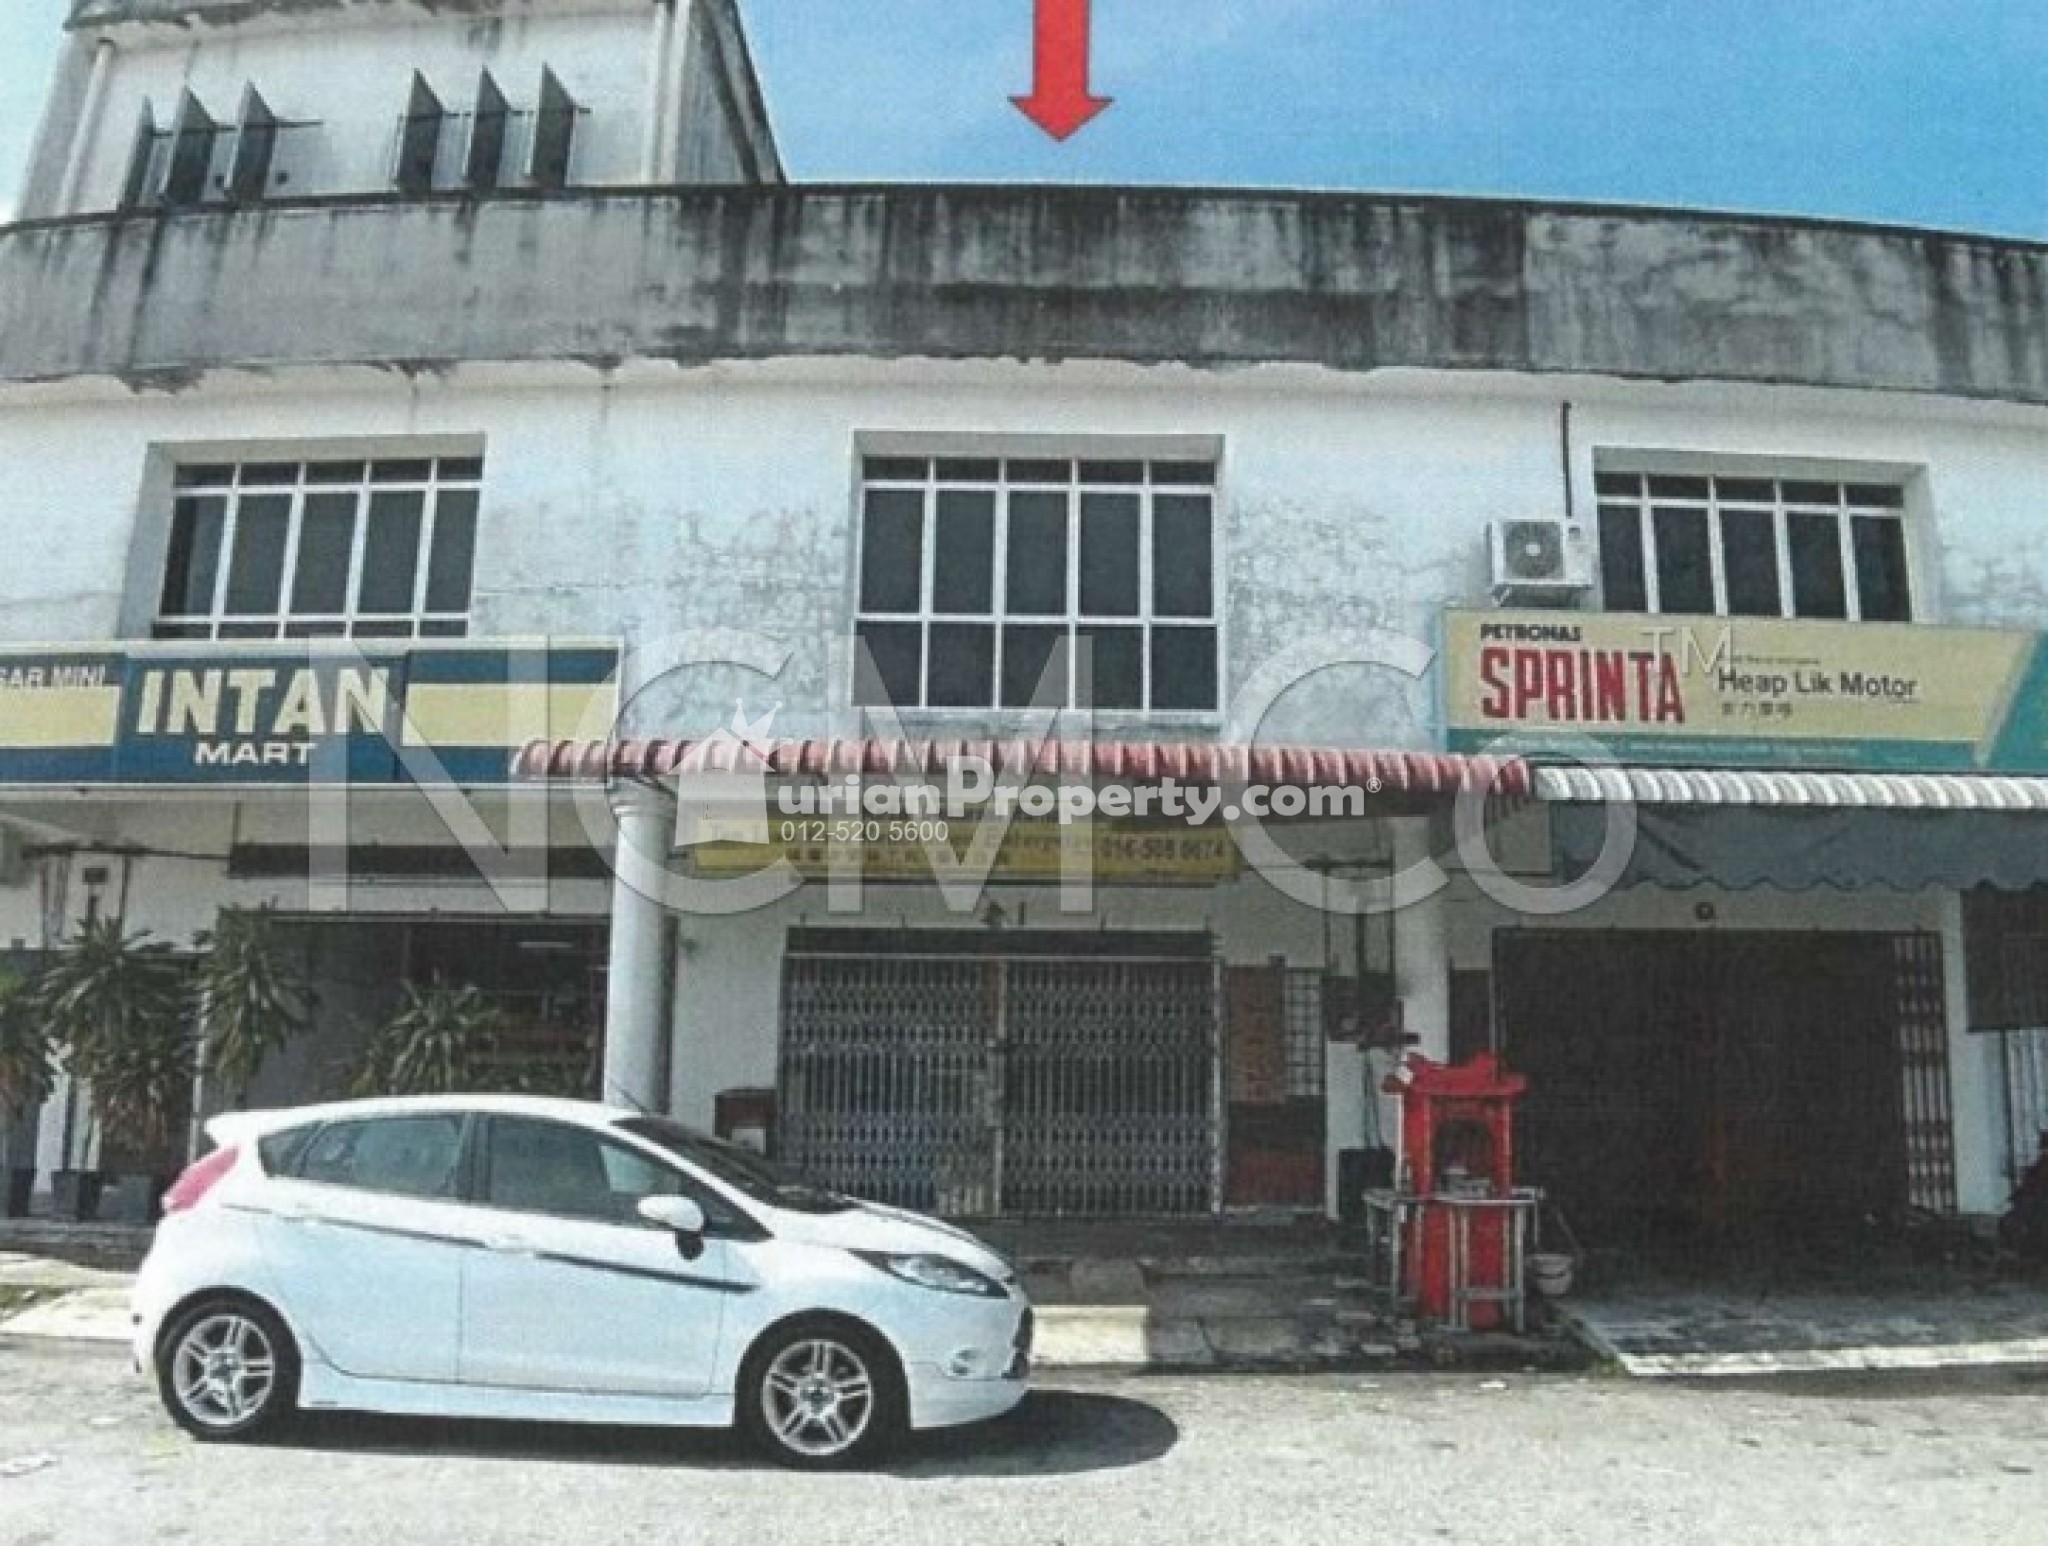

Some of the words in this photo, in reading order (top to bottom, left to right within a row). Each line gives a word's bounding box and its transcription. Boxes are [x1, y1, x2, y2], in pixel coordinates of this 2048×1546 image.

[1480, 623, 1582, 642] PETRONAS
[1479, 645, 1686, 726] SPRINTA
[1717, 667, 1788, 699] Heap
[1793, 670, 1834, 694] Lik
[1839, 671, 1920, 698] Motor
[136, 666, 390, 736] INTAN
[194, 741, 318, 766] MART
